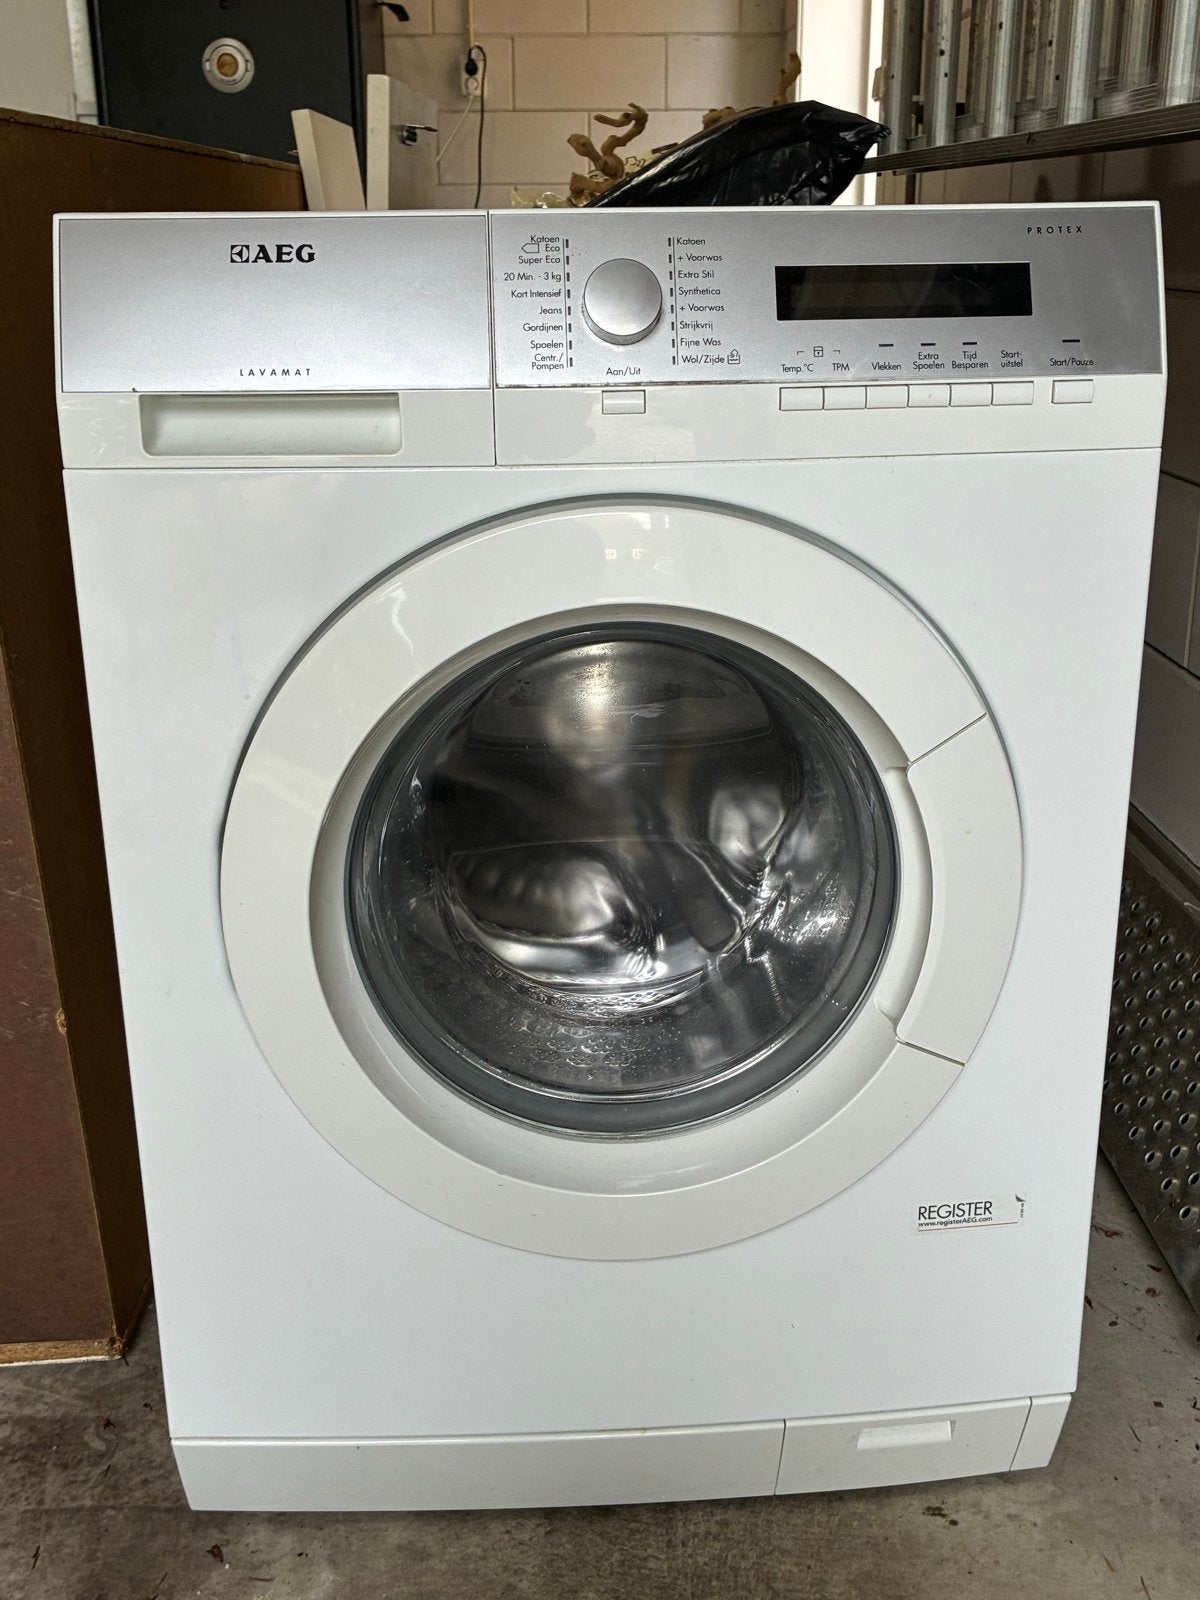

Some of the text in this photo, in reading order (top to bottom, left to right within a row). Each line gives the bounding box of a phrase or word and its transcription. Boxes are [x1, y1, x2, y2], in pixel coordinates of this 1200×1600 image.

[1027, 225, 1083, 235] PROTEX
[530, 235, 560, 243] Katoen
[676, 237, 706, 246] Katoen
[545, 243, 561, 252] Eco
[251, 243, 316, 263] AEG
[685, 253, 723, 262] Voorwas
[518, 255, 561, 266] Super Eco
[503, 272, 515, 281] 20
[517, 272, 536, 281] Min.
[543, 271, 549, 280] 3
[551, 271, 562, 283] kg
[677, 269, 715, 279] Extra Stil
[511, 288, 562, 298] Kort Intensief
[678, 286, 721, 297] Synthetica
[539, 306, 563, 315] Jeans
[687, 303, 725, 312] Voorwas
[522, 322, 563, 333] Gordijnen
[679, 320, 713, 331] Strijkvrij
[530, 339, 564, 350] Spoelen
[680, 338, 722, 348] Fijne Was
[534, 352, 564, 362] Centr./
[918, 351, 939, 361] Extra
[962, 350, 978, 362] Tijd
[1000, 350, 1022, 359] Start-
[681, 355, 725, 366] Wol/Zijde
[912, 360, 945, 371] Spoelen
[951, 360, 989, 370] Besparen
[1000, 358, 1024, 368] uitstel
[1049, 357, 1094, 367] Start/Pauze
[531, 361, 565, 372] Pompen
[605, 367, 641, 376] Aan/Uit
[832, 363, 850, 371] TPM
[871, 362, 901, 371] Vlekken
[239, 368, 311, 377] LAVAMAT
[917, 1200, 993, 1221] REGISTER
[918, 1216, 993, 1227] www.registerAEG.com
